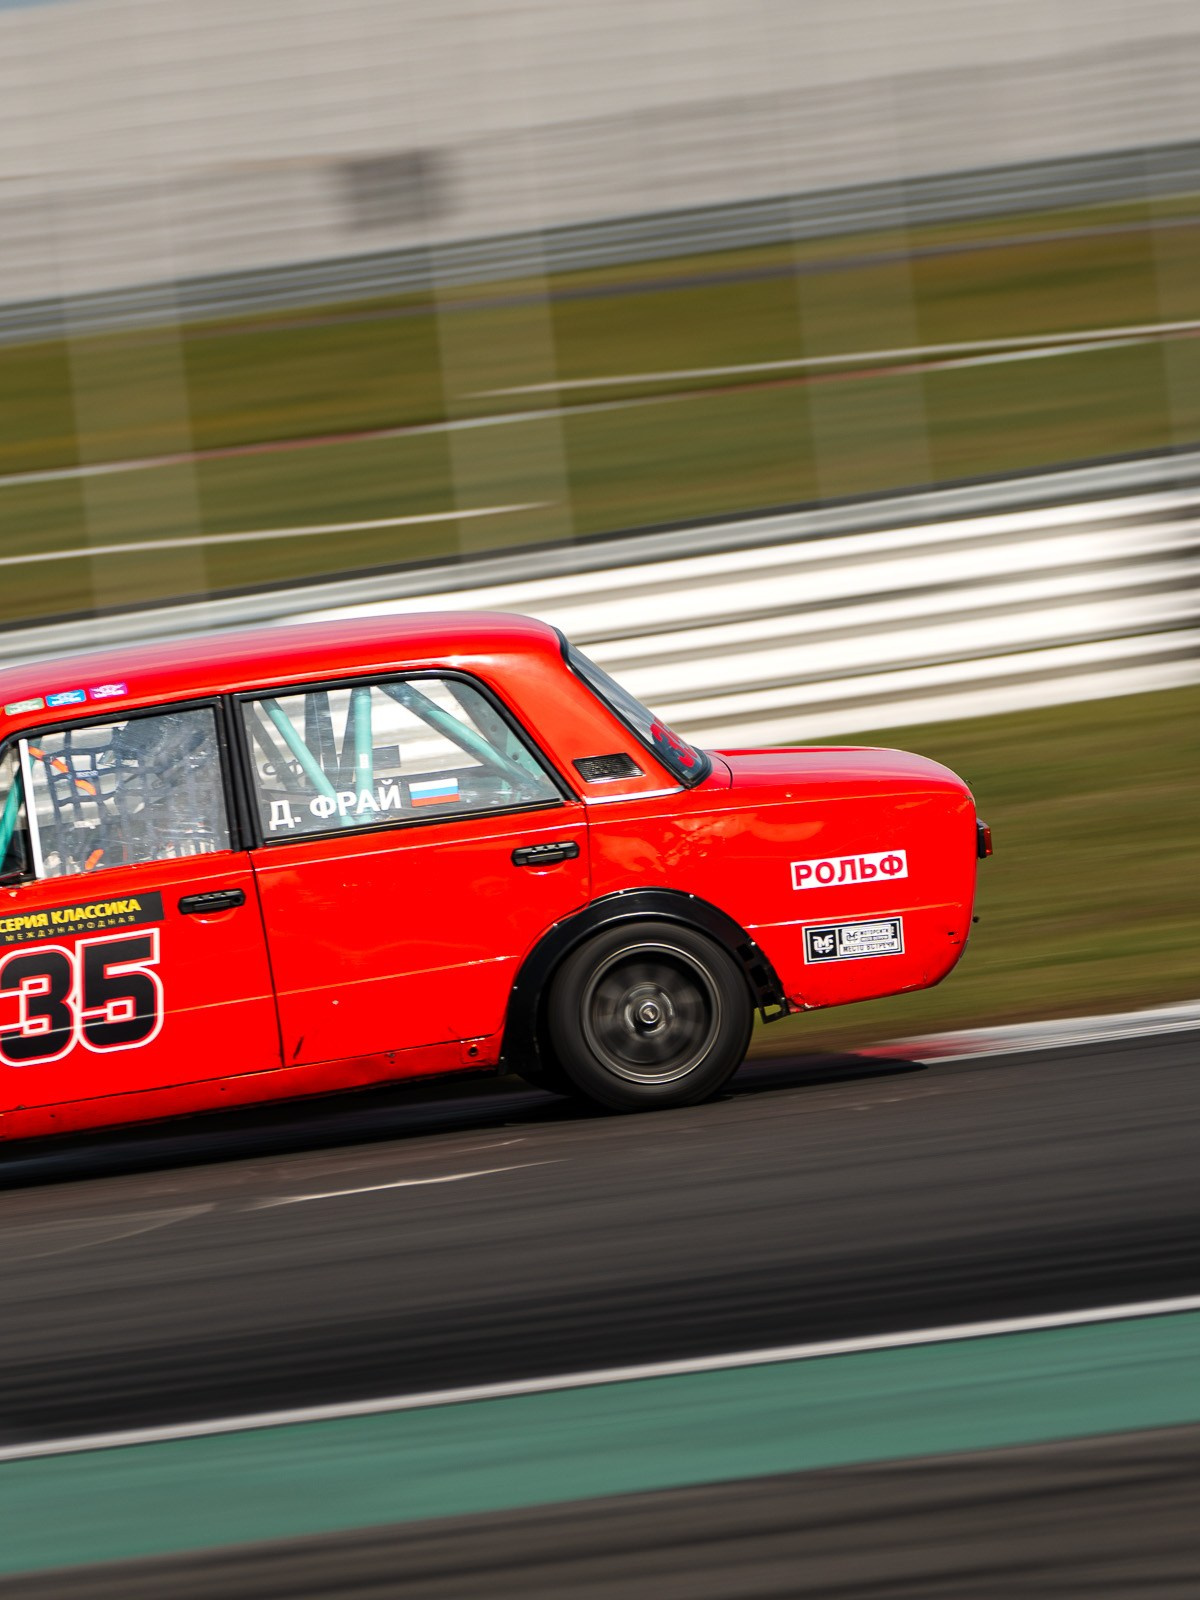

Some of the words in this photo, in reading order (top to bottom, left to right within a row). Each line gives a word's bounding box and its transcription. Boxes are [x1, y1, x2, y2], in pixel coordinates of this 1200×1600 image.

[269, 799, 302, 831] Д.
[309, 779, 402, 819] ФРАЙ
[794, 855, 904, 887] РОЛЬФ
[51, 898, 142, 925] КЛАССИКА
[5, 915, 136, 942] МЕЖДУНАРОДНАЯ
